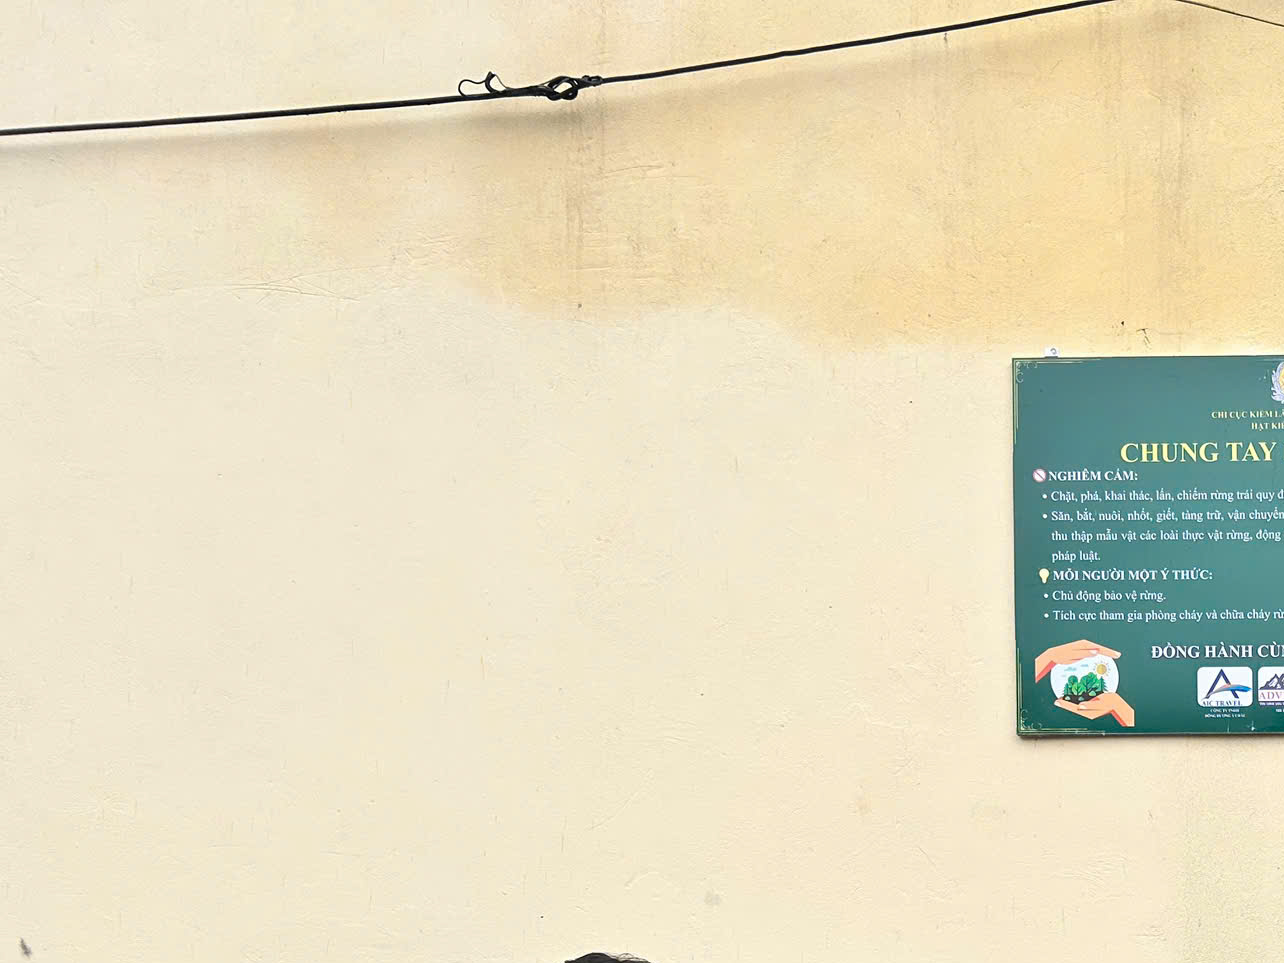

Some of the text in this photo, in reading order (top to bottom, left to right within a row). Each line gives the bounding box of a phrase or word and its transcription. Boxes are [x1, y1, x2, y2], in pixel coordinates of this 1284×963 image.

[1211, 411, 1228, 419] CHI
[1229, 411, 1248, 420] CỤC
[1251, 422, 1270, 431] HẠT
[1120, 442, 1219, 463] CHUNG
[1225, 442, 1277, 462] TAY
[1048, 468, 1101, 481] NGHIÊM
[1050, 490, 1078, 502] Chặt,
[1080, 490, 1102, 503] phá,
[1105, 490, 1126, 501] khai
[1129, 490, 1153, 502] thác,
[1176, 487, 1208, 500] chiếm
[1210, 490, 1234, 502] rừng
[1236, 489, 1253, 500] trái
[1255, 491, 1275, 502] quy
[1051, 510, 1074, 522] Săn,
[1099, 510, 1124, 522] nuôi,
[1127, 507, 1153, 522] nhốt,
[1156, 507, 1178, 522] giết,
[1181, 510, 1204, 522] tàng
[1227, 509, 1245, 521] vận
[1051, 530, 1068, 541] thu
[1071, 530, 1093, 543] thập
[1096, 528, 1118, 541] mẫu
[1121, 530, 1136, 542] vật
[1140, 530, 1157, 540] các
[1160, 530, 1179, 540] loài
[1182, 530, 1204, 542] thực
[1207, 529, 1223, 541] vật
[1226, 529, 1253, 542] rừng,
[1255, 529, 1281, 541] động
[1051, 550, 1101, 563] pháp luật.
[1082, 568, 1125, 581] NGƯỜI
[1128, 569, 1158, 583] MỘT
[1160, 567, 1170, 580] Ý
[1172, 567, 1213, 580] THỨC:
[1052, 590, 1166, 603] Chủ động bảo vệ rừng.
[1052, 610, 1076, 620] Tích
[1078, 612, 1097, 622] cực
[1099, 610, 1125, 620] tham
[1127, 610, 1143, 623] gia
[1145, 610, 1177, 622] phòng
[1179, 609, 1203, 622] cháy
[1206, 610, 1218, 620] và
[1220, 609, 1244, 620] chữa
[1247, 609, 1271, 621] cháy
[1151, 641, 1200, 659] ĐỒNG
[1204, 641, 1253, 658] HÀNH
